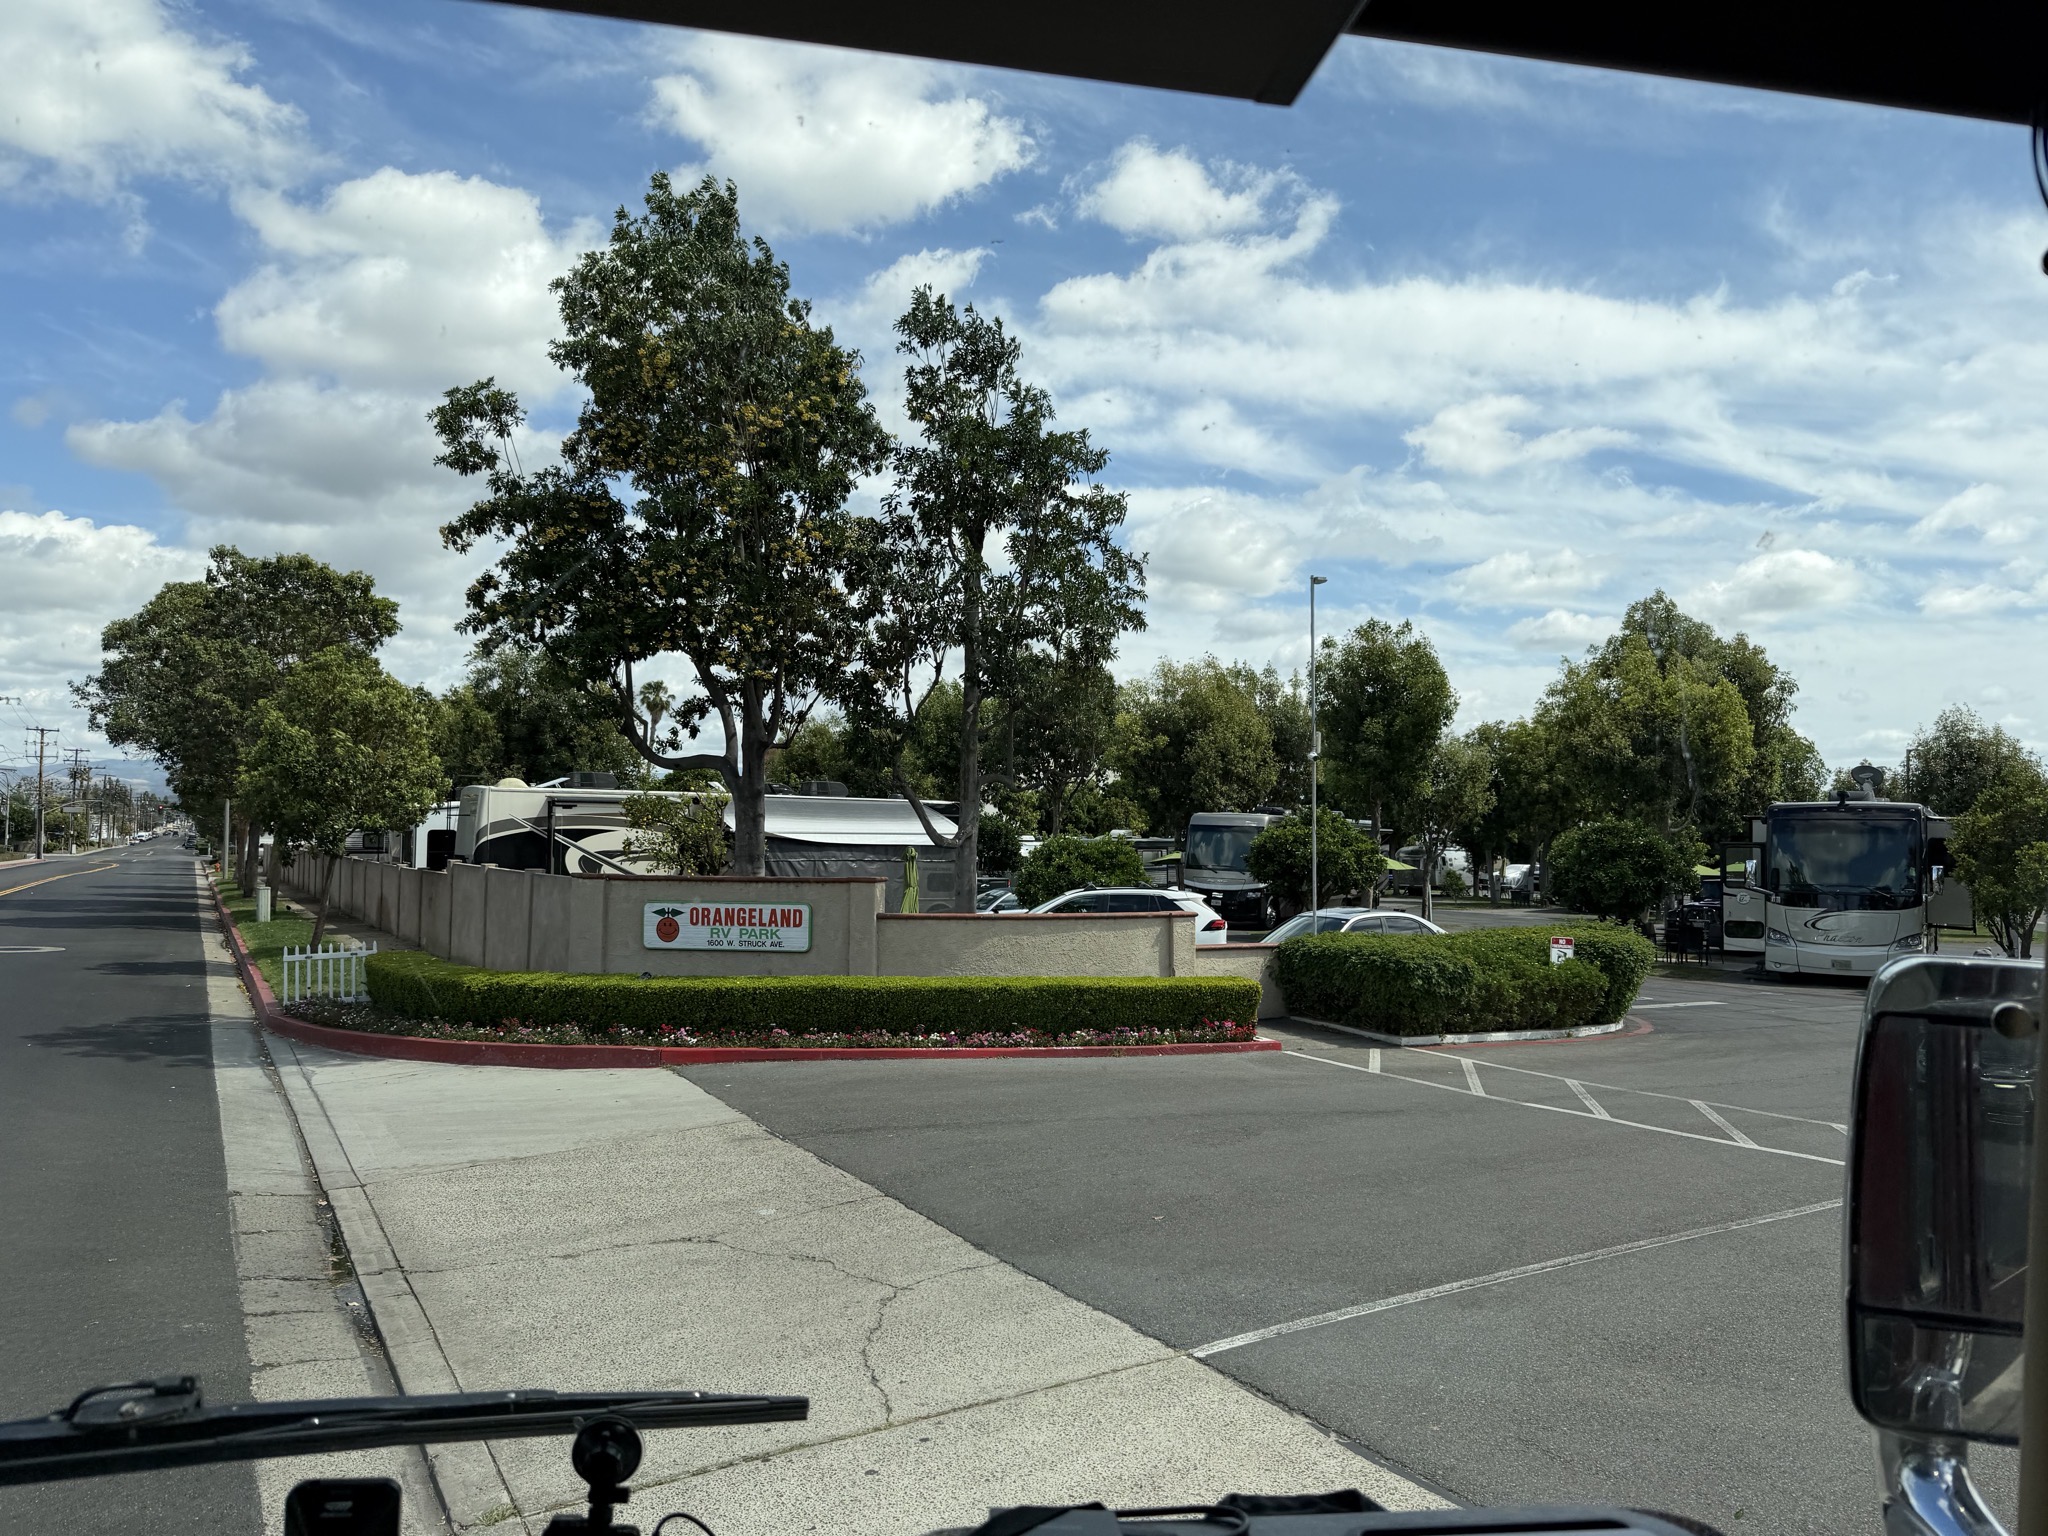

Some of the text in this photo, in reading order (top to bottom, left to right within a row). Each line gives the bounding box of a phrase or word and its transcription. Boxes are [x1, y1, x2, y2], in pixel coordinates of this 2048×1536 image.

[690, 907, 803, 928] ORANGELAND
[710, 928, 781, 940] RV PARK
[739, 940, 767, 948] STRUCK
